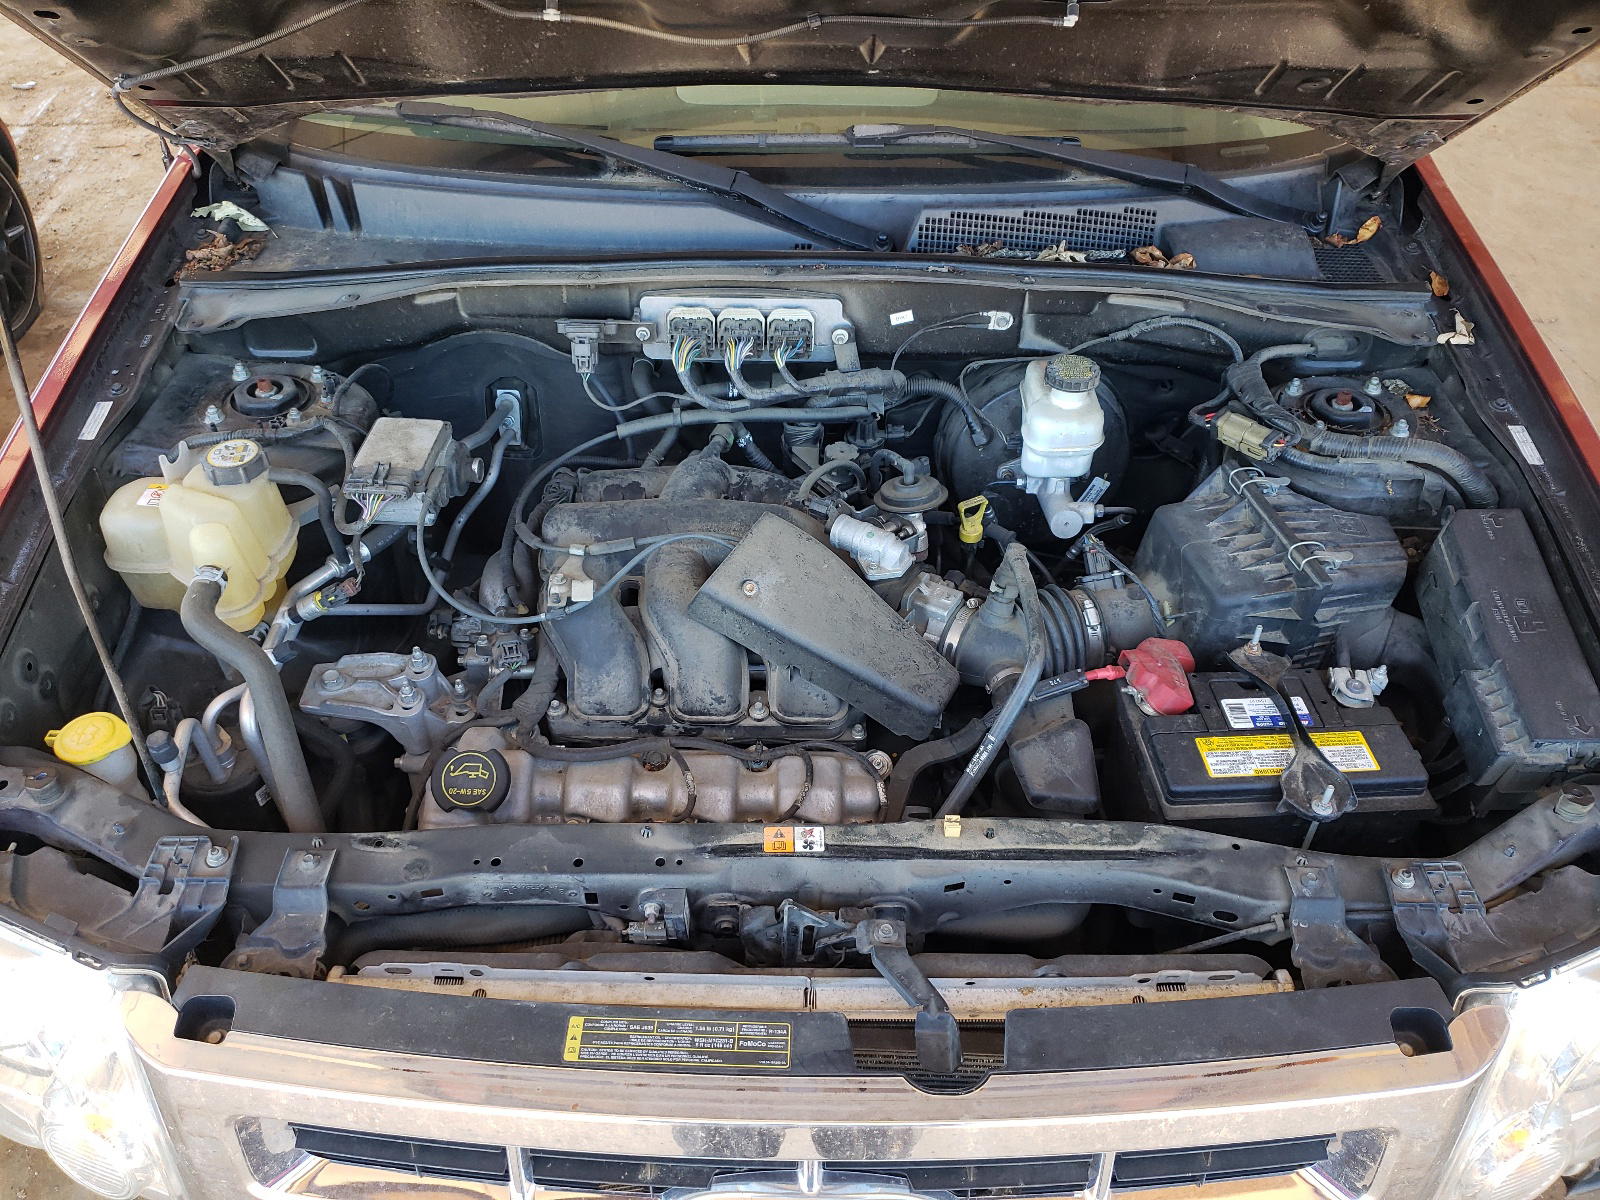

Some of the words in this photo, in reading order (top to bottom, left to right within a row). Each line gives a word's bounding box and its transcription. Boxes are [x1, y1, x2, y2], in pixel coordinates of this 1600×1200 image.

[448, 787, 472, 796] 5W-20
[472, 788, 487, 796] SAE
[739, 1040, 767, 1048] FoMoCo
